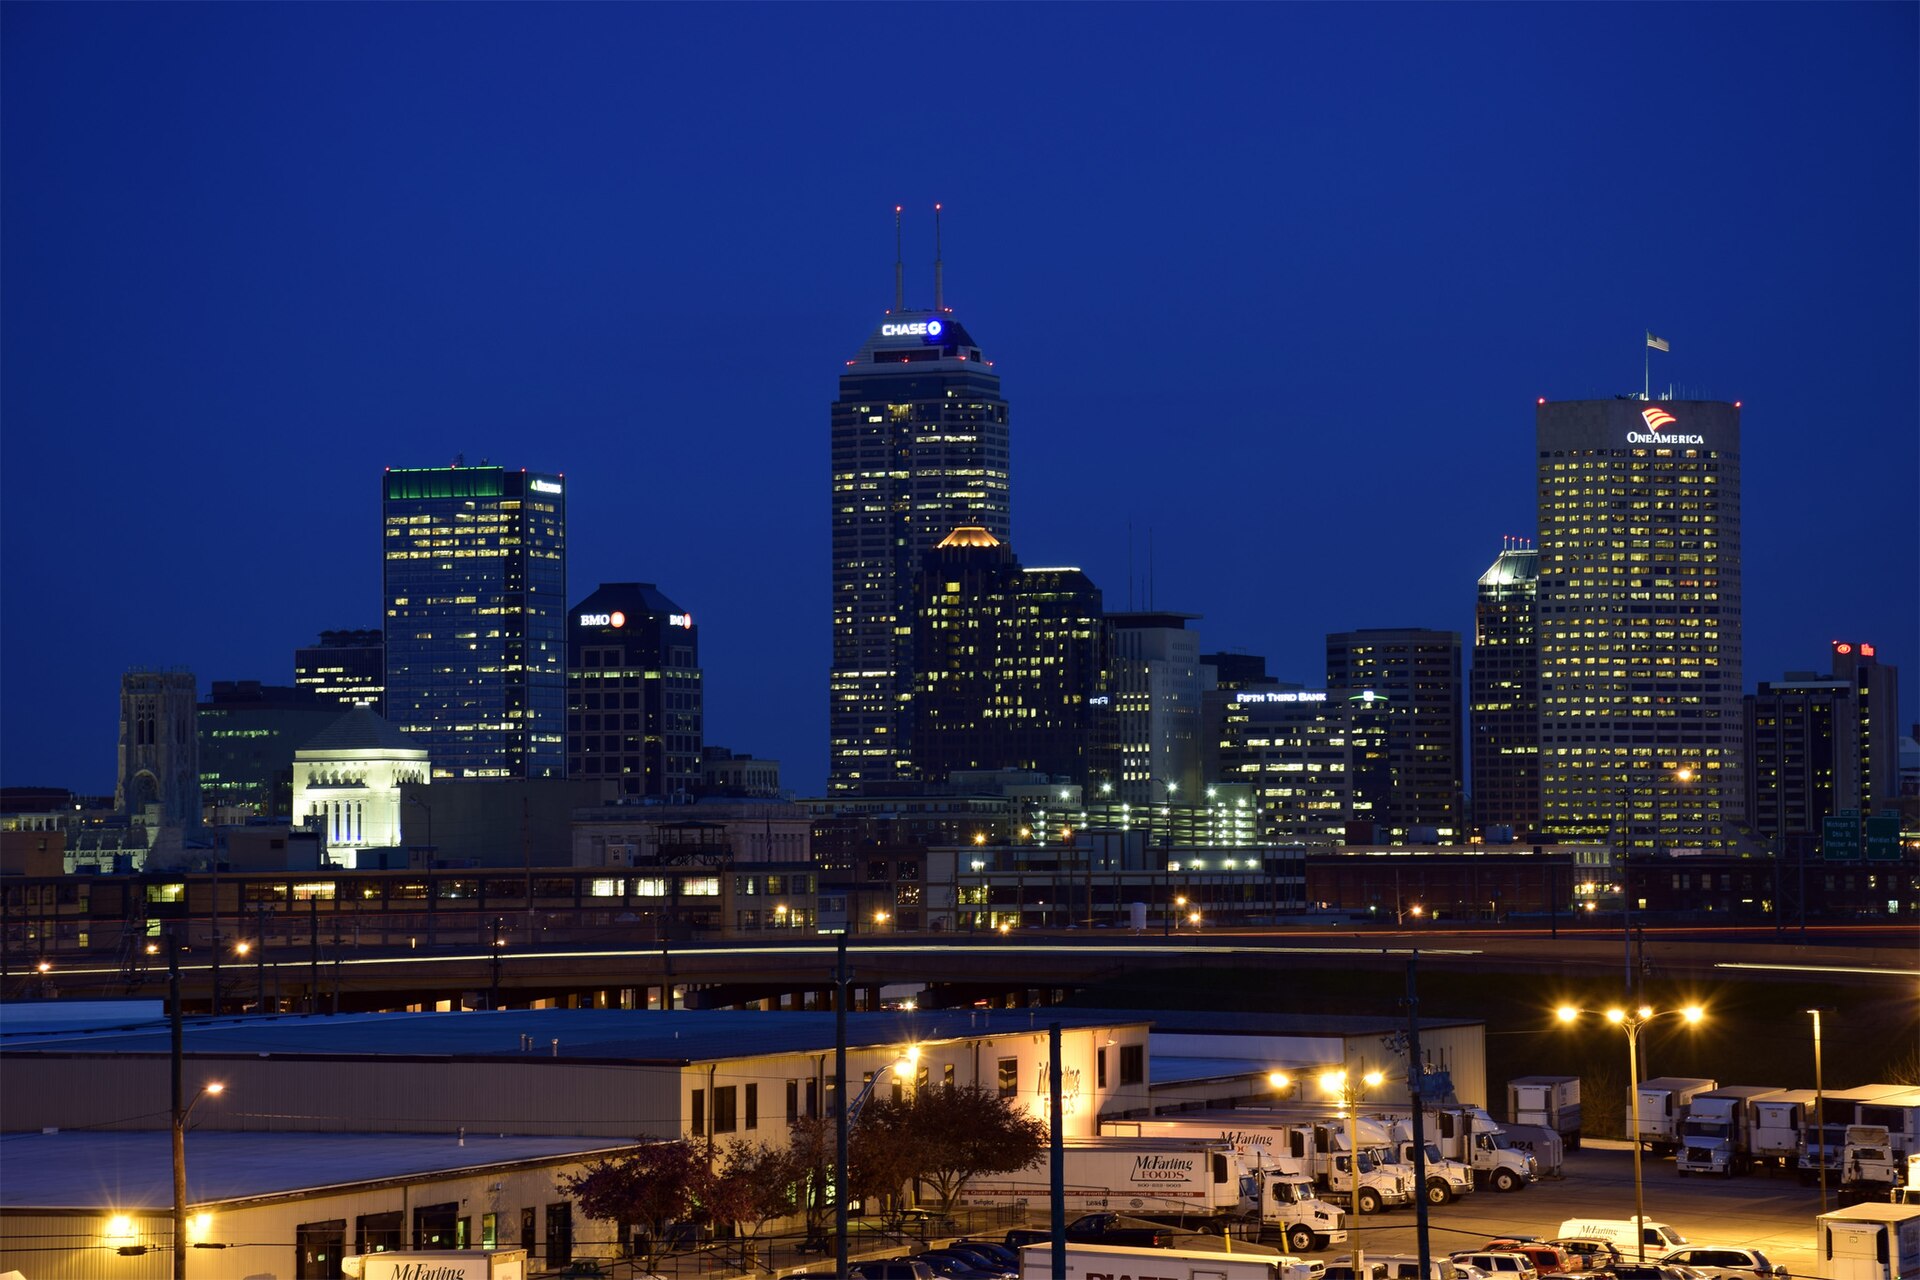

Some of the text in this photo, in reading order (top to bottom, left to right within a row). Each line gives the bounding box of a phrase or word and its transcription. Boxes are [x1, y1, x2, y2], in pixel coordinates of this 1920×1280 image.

[882, 322, 927, 336] CHASE
[580, 614, 610, 626] BMO
[1298, 692, 1327, 702] BANK
[1135, 1155, 1193, 1171] McFarling
[1141, 1170, 1185, 1179] FOODS
[391, 1263, 465, 1280] McFarling
